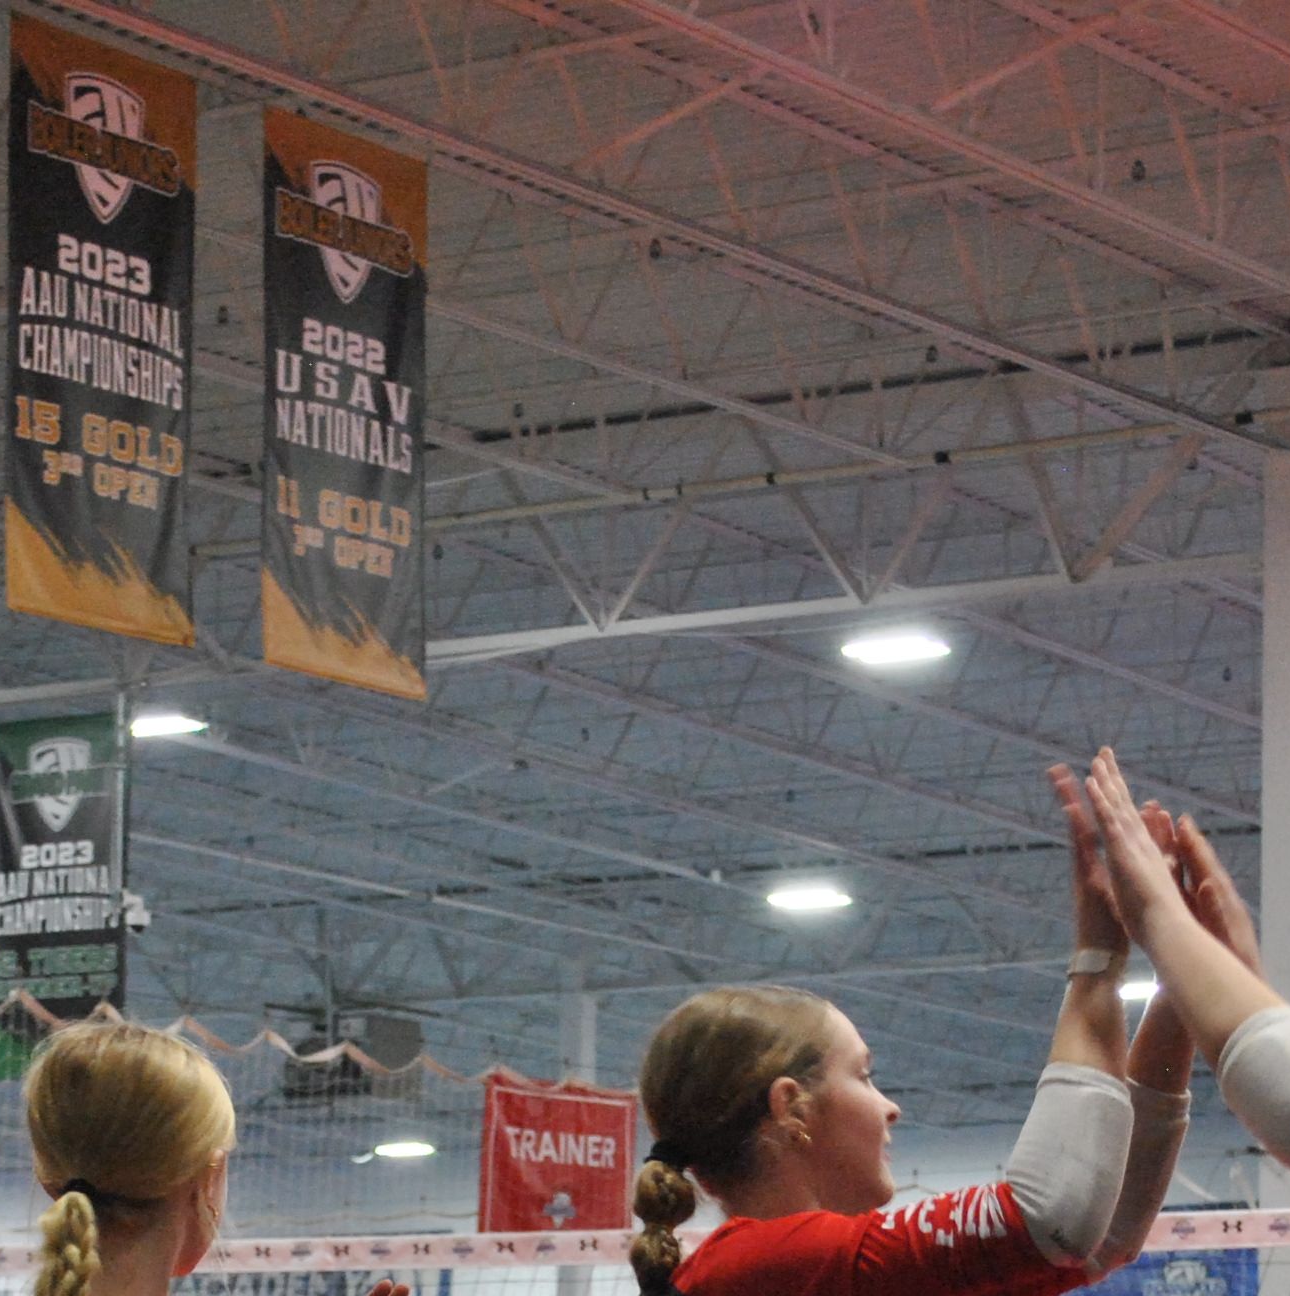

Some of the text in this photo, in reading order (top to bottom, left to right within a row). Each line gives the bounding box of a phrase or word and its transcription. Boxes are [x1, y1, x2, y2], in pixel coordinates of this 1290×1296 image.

[57, 233, 152, 296] 2023
[19, 266, 184, 359] AAU NATIONAL
[19, 324, 183, 411] CHAMPIONSHIPS
[302, 317, 386, 375] 2022
[15, 396, 183, 478] 15 GOLD
[276, 398, 412, 474] NATIONALS
[93, 462, 161, 511] OPEN
[318, 488, 411, 547] GOLD
[20, 840, 93, 868] 2023
[32, 866, 110, 898] NATIONA
[506, 1126, 616, 1169] TRAINER
